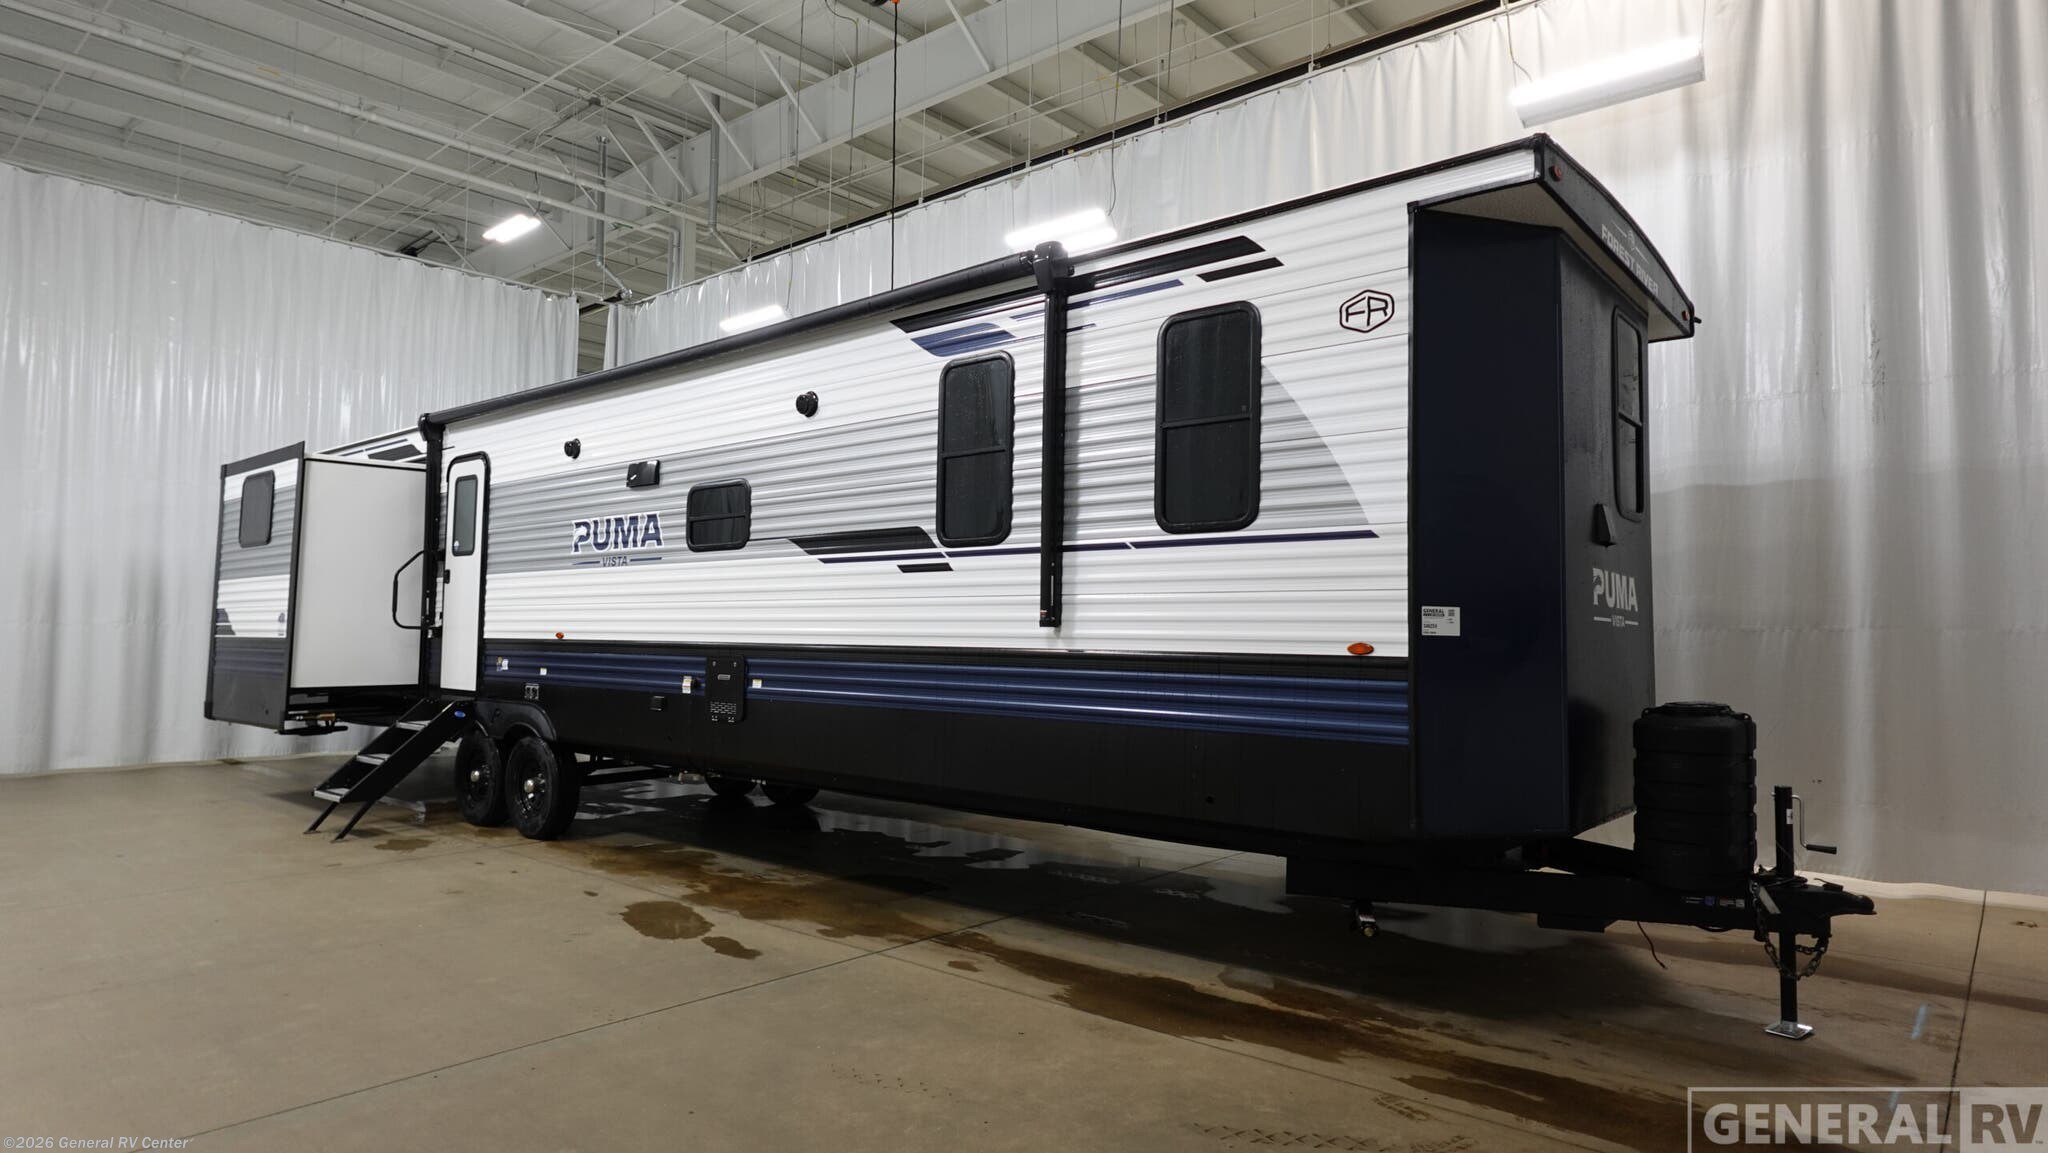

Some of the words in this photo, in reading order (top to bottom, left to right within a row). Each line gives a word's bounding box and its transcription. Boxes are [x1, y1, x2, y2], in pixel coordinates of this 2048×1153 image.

[1602, 223, 1635, 271] FOREST
[1636, 262, 1659, 298] RIVER
[572, 512, 663, 553] PUMA
[602, 556, 628, 568] VISTA
[1593, 567, 1638, 612] PUMA
